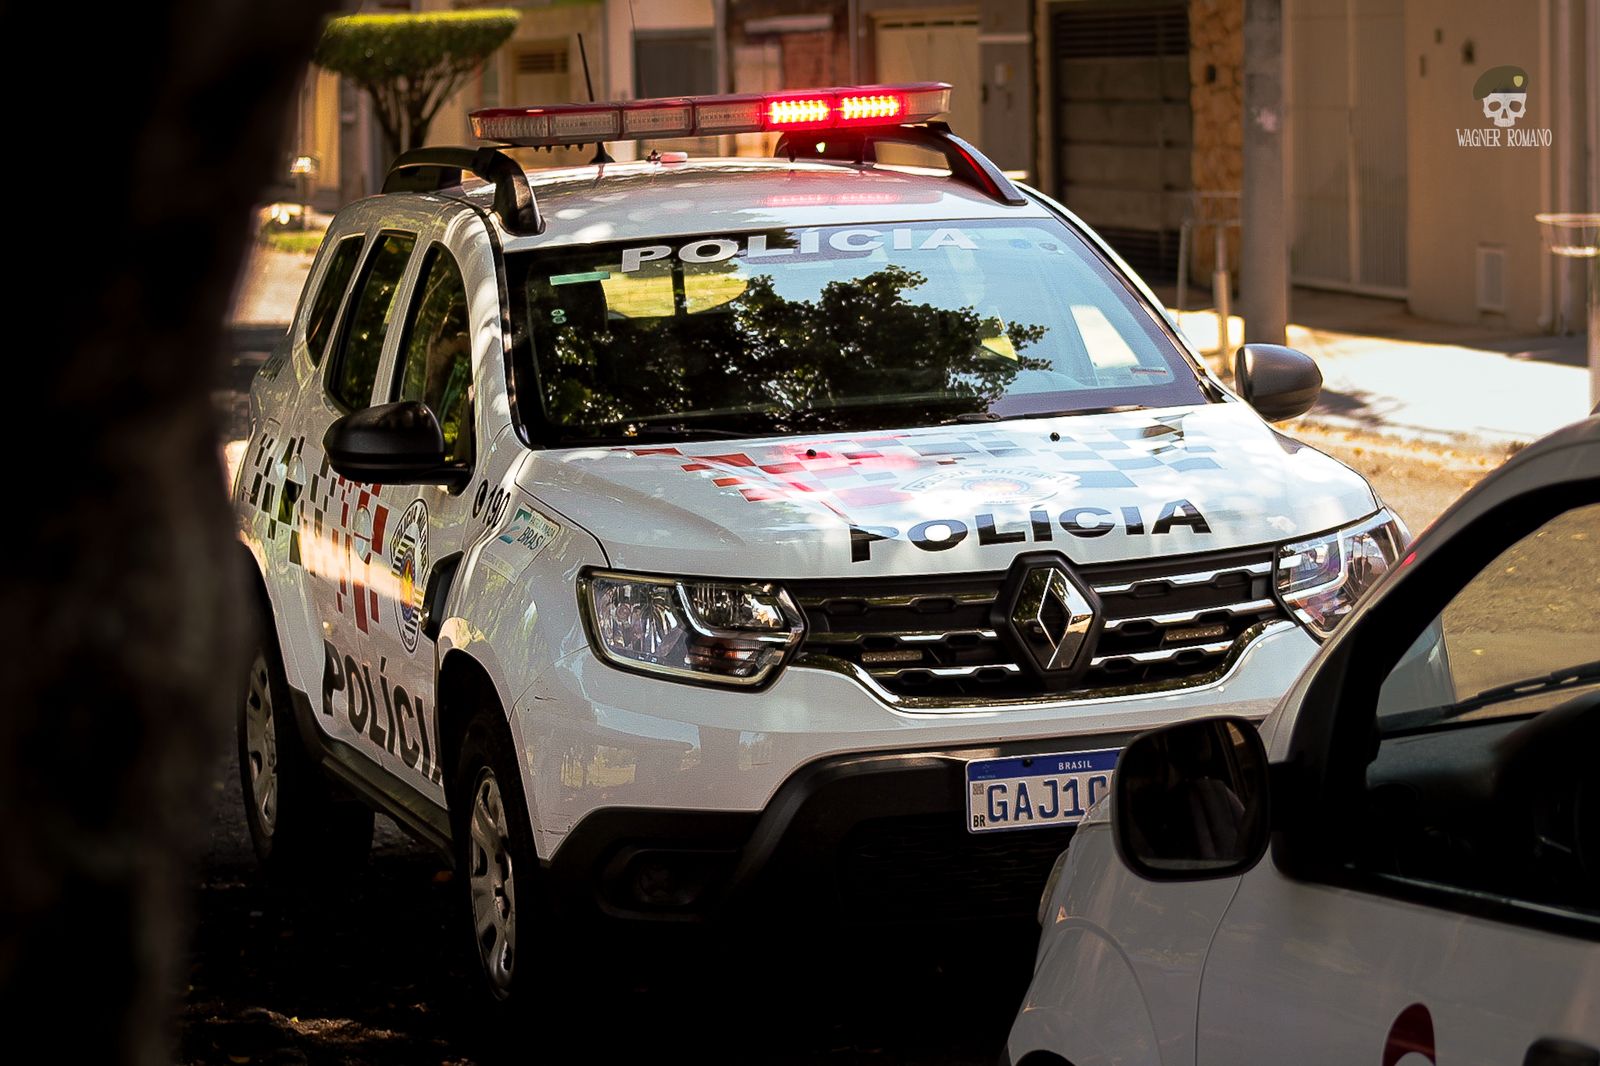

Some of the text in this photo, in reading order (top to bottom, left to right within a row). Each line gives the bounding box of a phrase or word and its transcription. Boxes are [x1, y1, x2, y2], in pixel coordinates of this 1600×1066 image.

[621, 227, 980, 274] POLÍCIA
[482, 484, 512, 530] 190
[517, 526, 547, 550] BRASI
[849, 499, 1213, 564] POLÍCIA
[1058, 760, 1093, 771] BRASIL
[973, 814, 986, 828] BR
